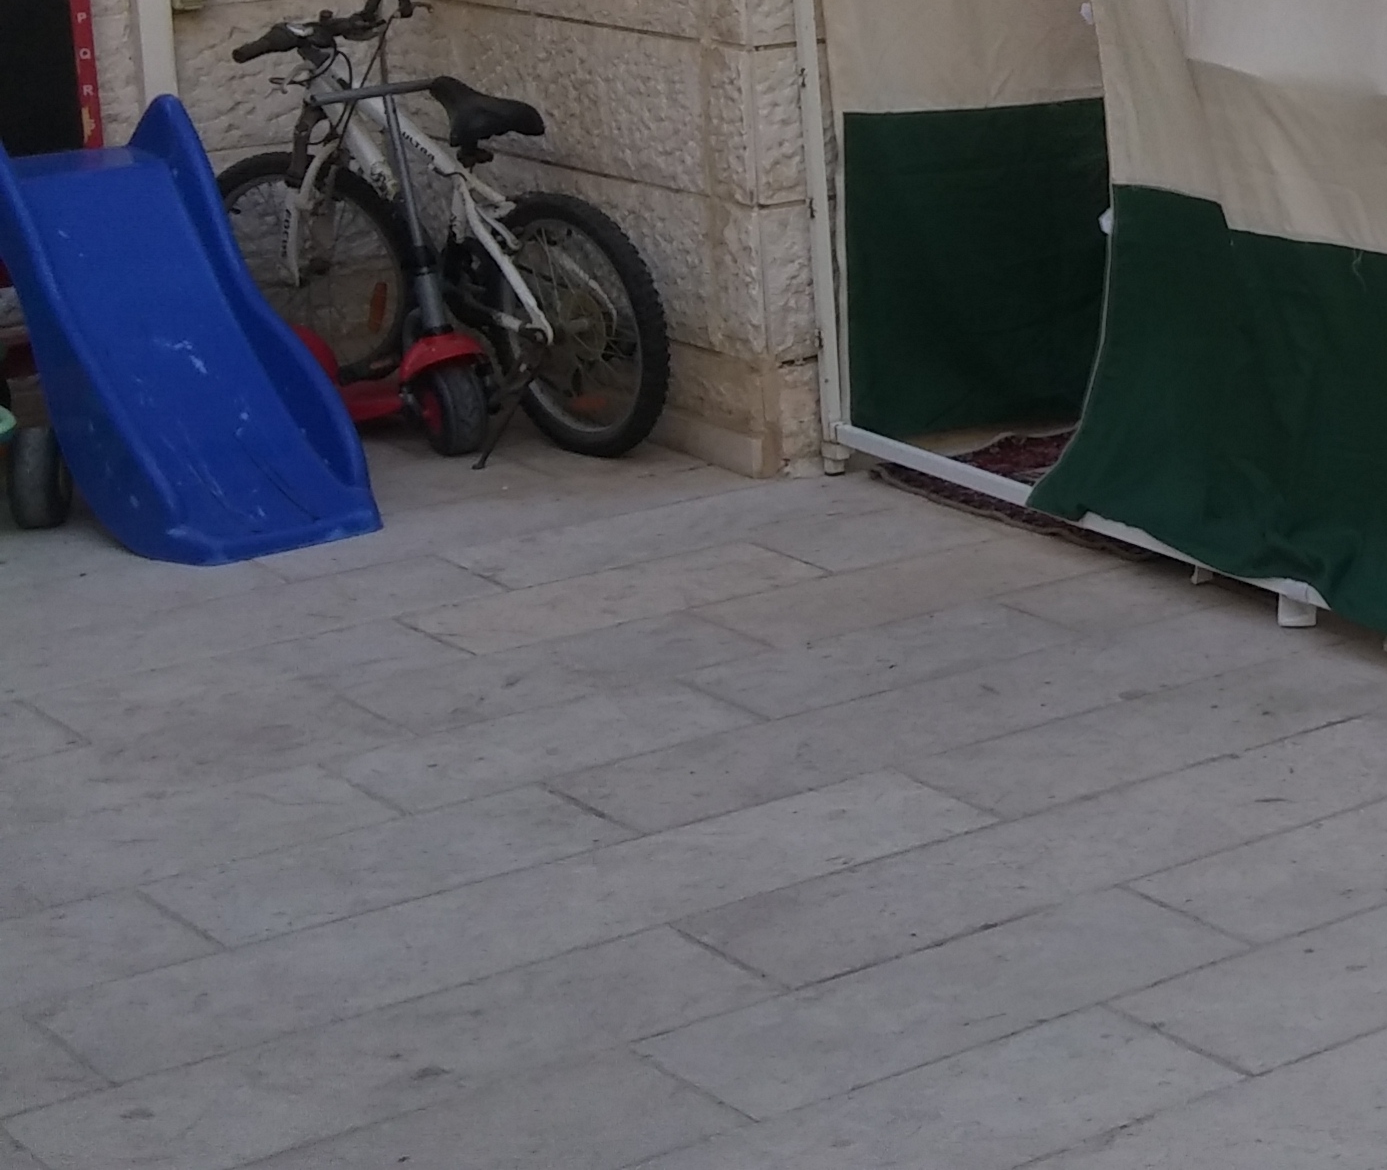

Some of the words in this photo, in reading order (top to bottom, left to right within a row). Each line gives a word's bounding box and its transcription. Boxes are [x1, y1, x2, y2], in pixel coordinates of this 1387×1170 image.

[76, 12, 87, 23] P
[79, 47, 91, 60] Q
[82, 84, 94, 96] R
